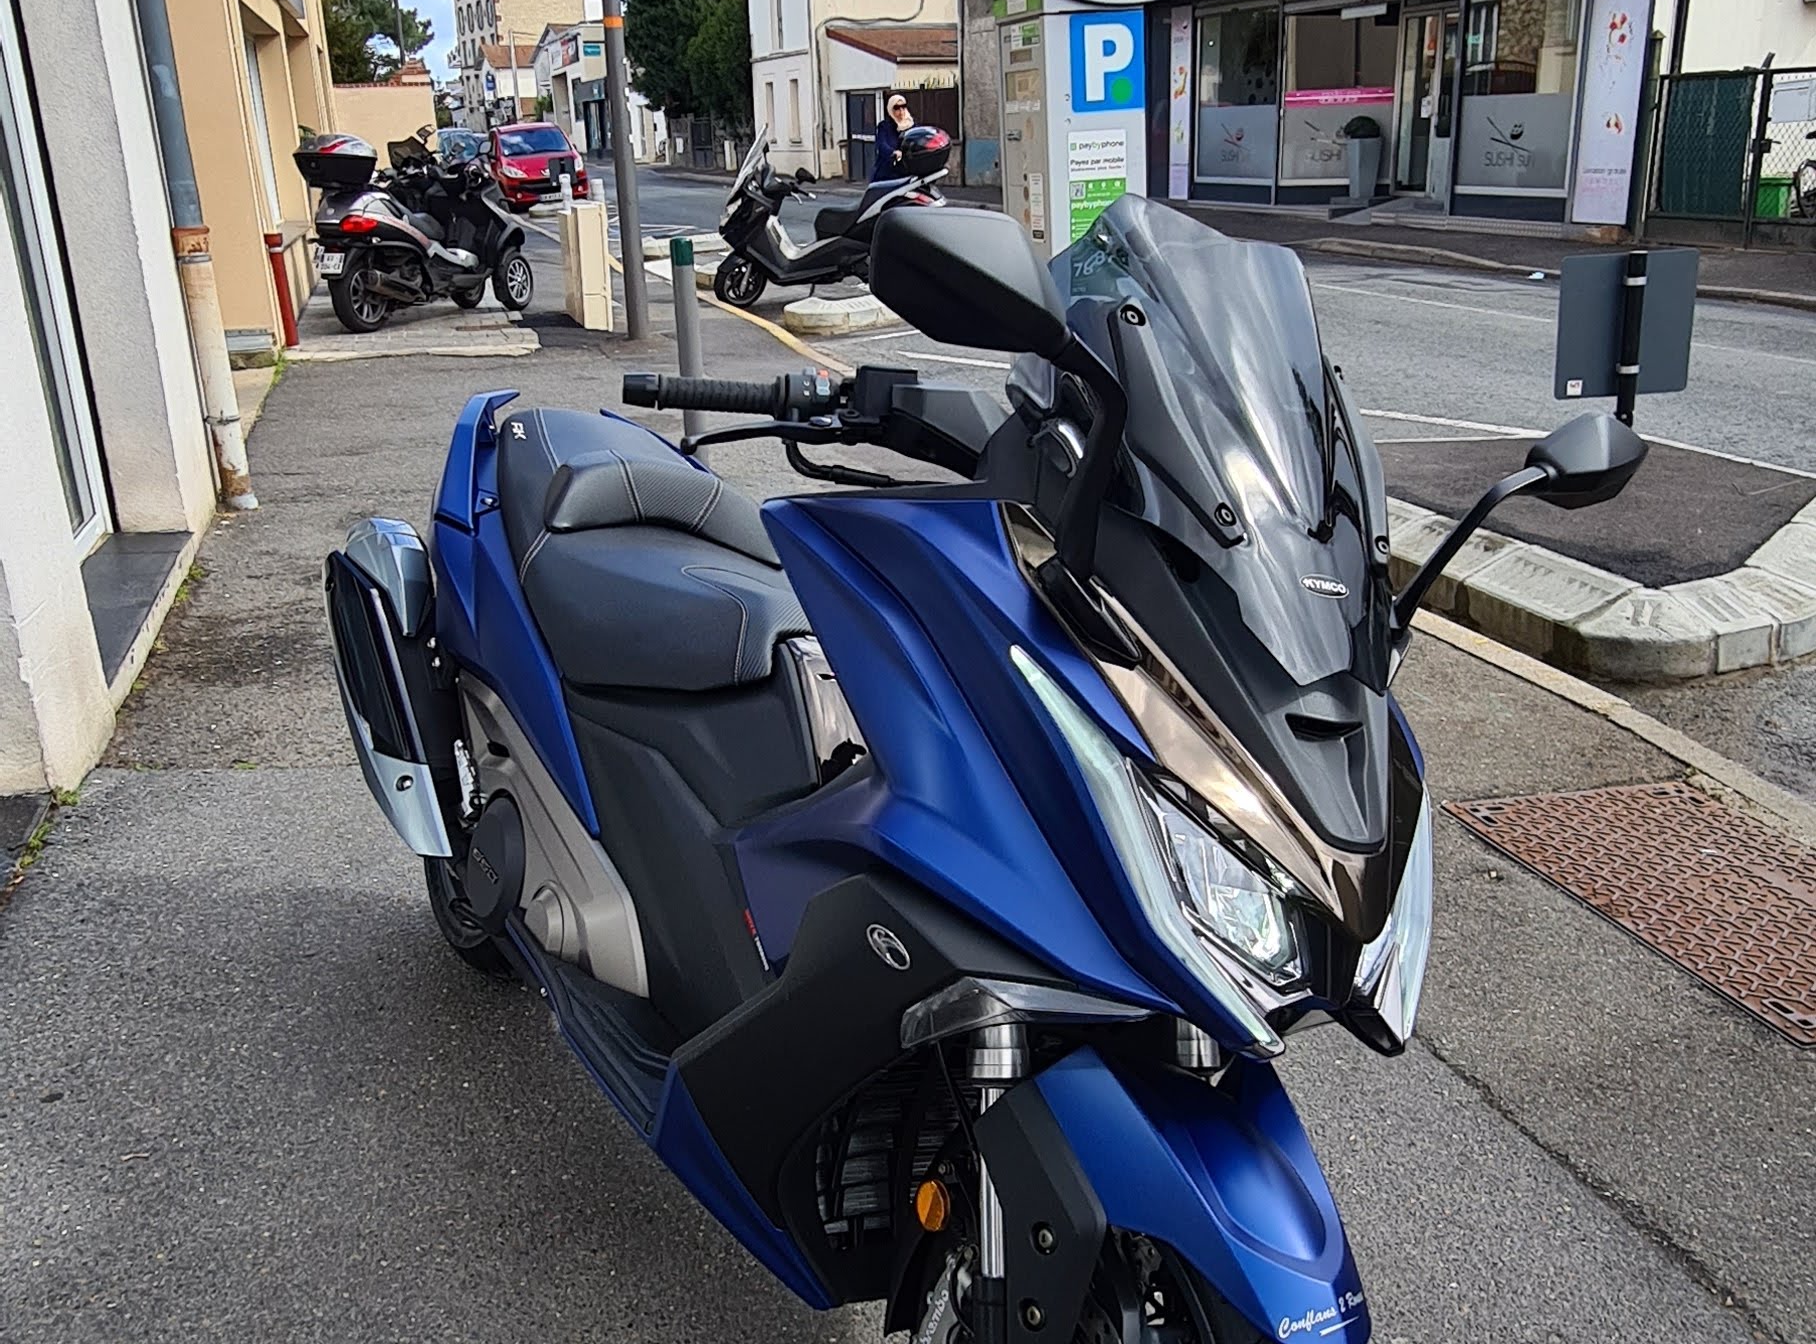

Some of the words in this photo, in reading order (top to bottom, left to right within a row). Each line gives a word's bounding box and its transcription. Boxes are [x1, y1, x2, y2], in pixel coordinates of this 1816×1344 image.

[1084, 23, 1134, 103] P
[1302, 578, 1347, 594] KYMCO
[1278, 1306, 1338, 1339] Conflans
